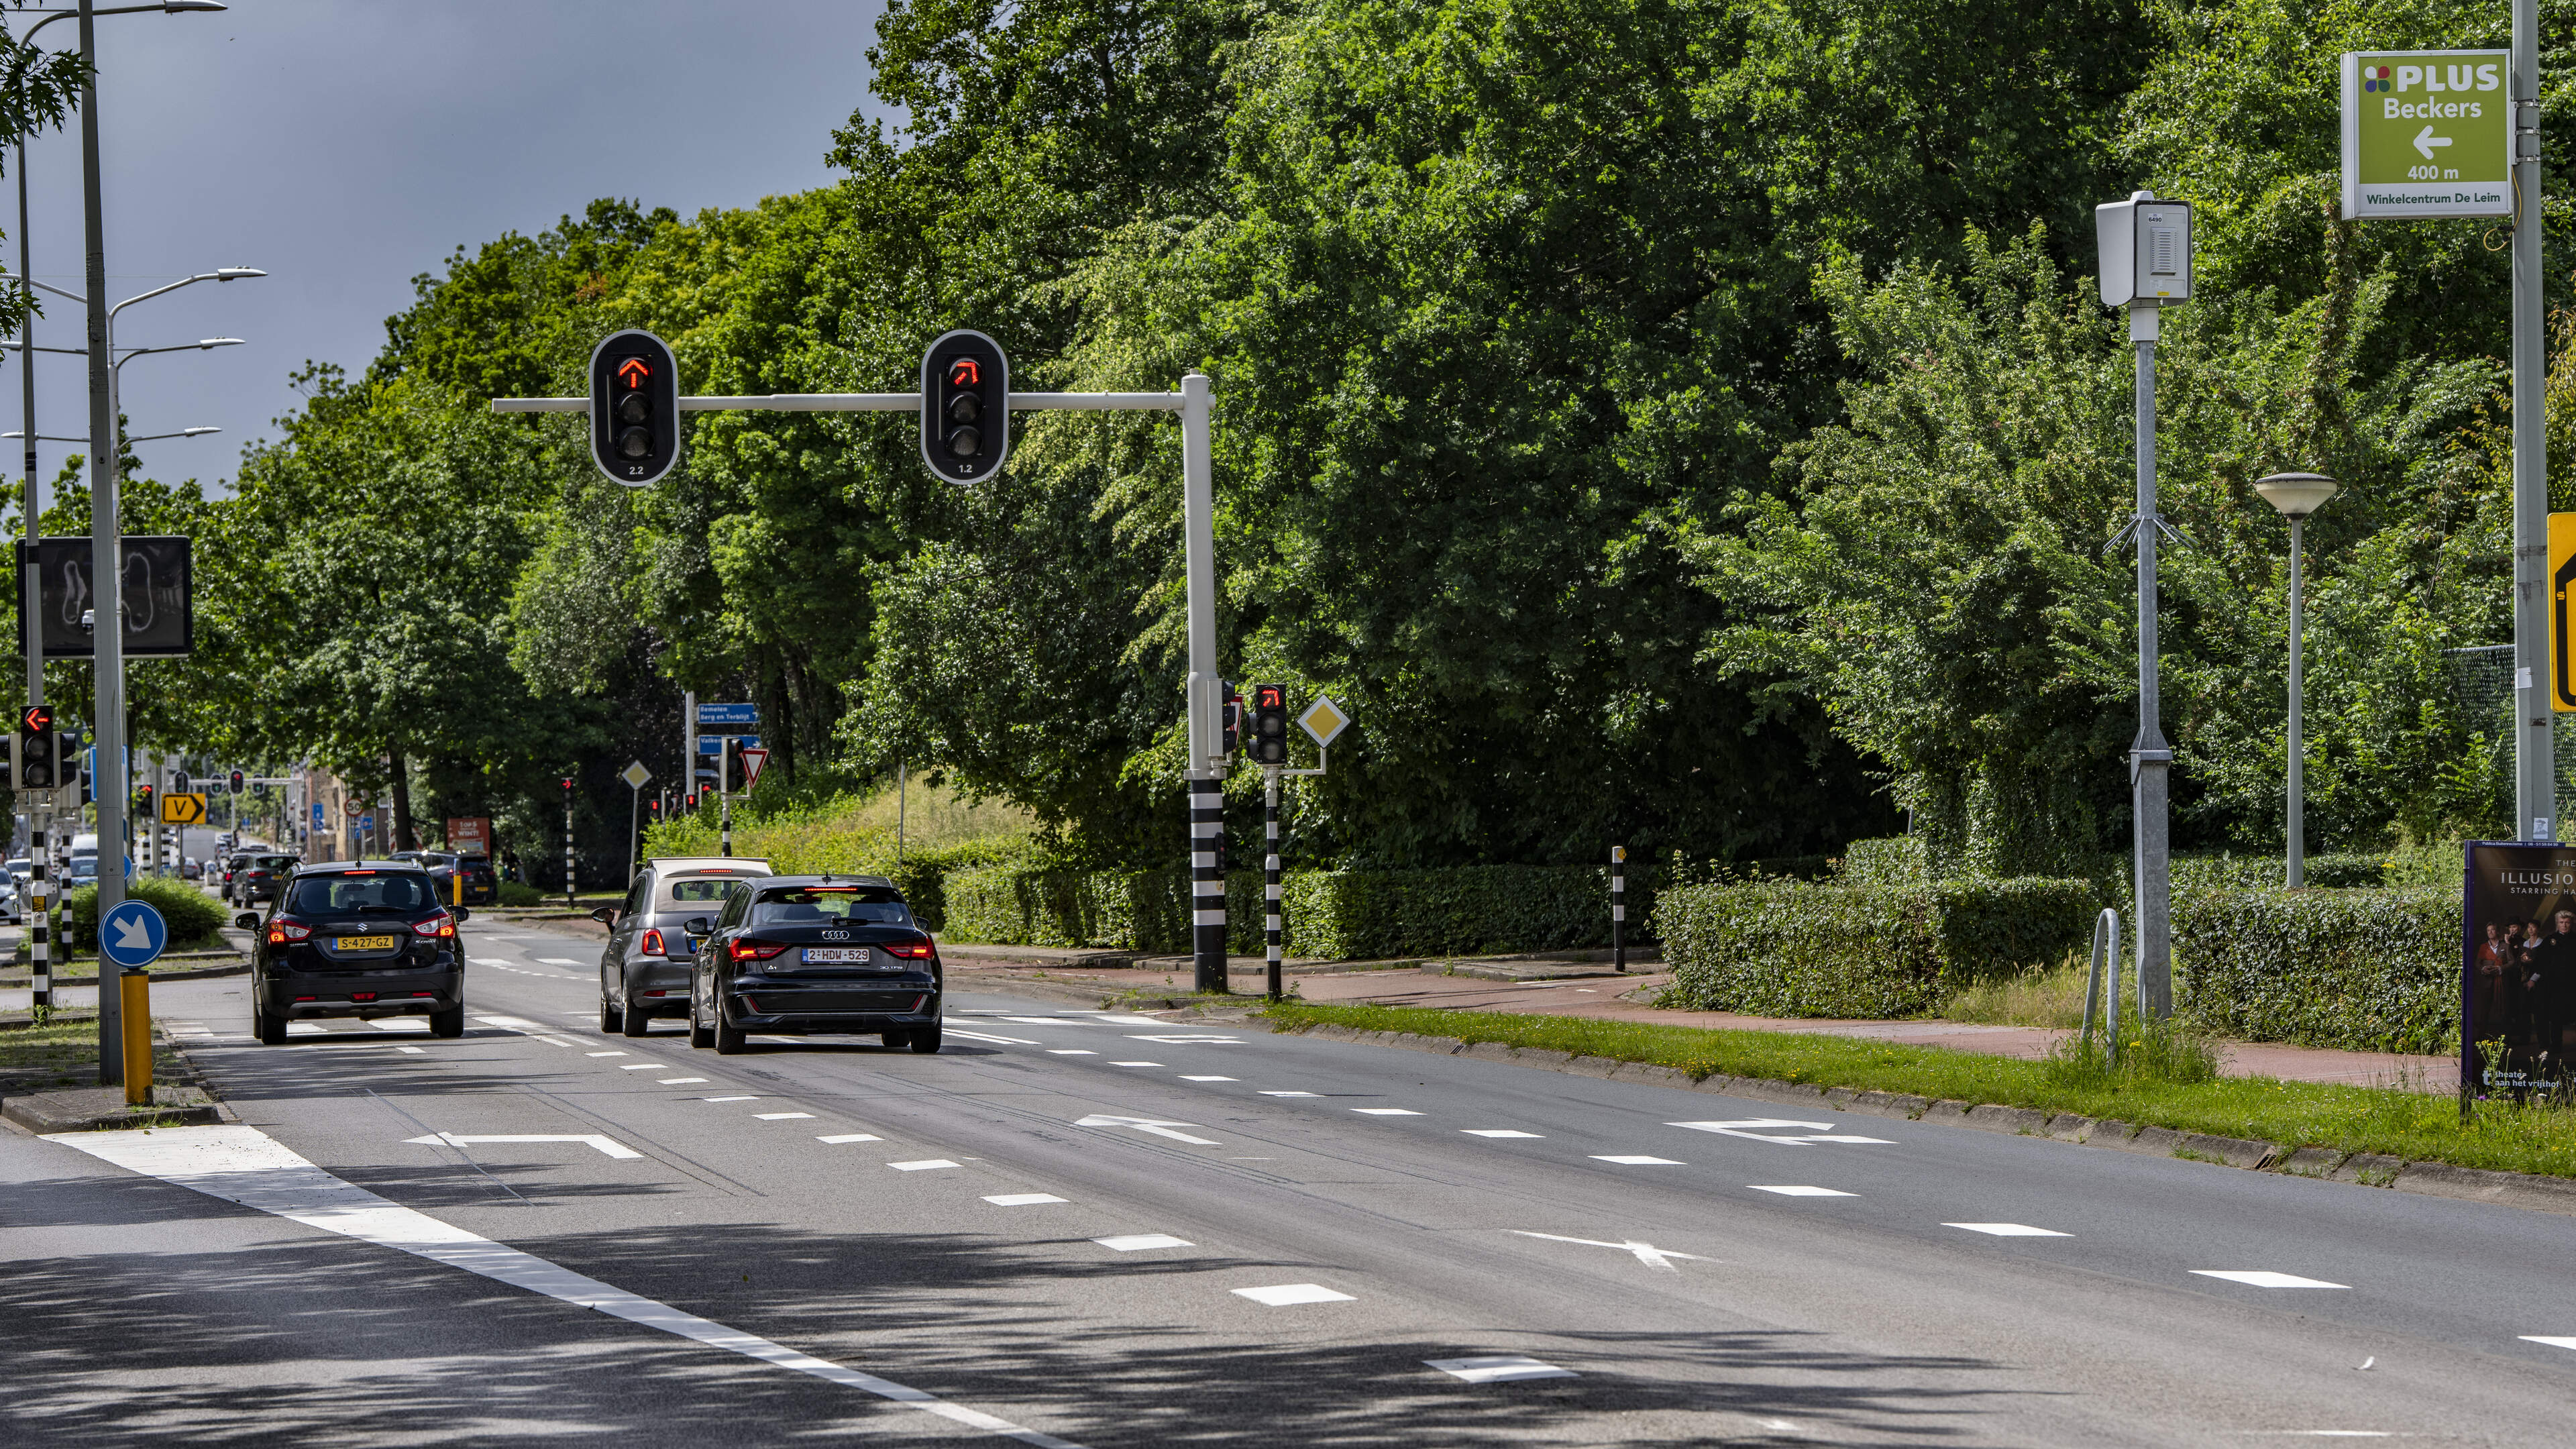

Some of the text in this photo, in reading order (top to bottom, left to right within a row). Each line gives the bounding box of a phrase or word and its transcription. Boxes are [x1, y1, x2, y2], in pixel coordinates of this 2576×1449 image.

[2397, 64, 2500, 92] PLUS
[2384, 96, 2482, 119] Beckers
[2408, 165, 2459, 180] 400 m
[2367, 192, 2501, 205] Winkelcentrum De Leim
[629, 466, 644, 475] 2.2
[959, 464, 973, 473] 1.2
[174, 799, 187, 816] V
[347, 802, 361, 811] 50
[341, 937, 390, 948] S-427-GZ
